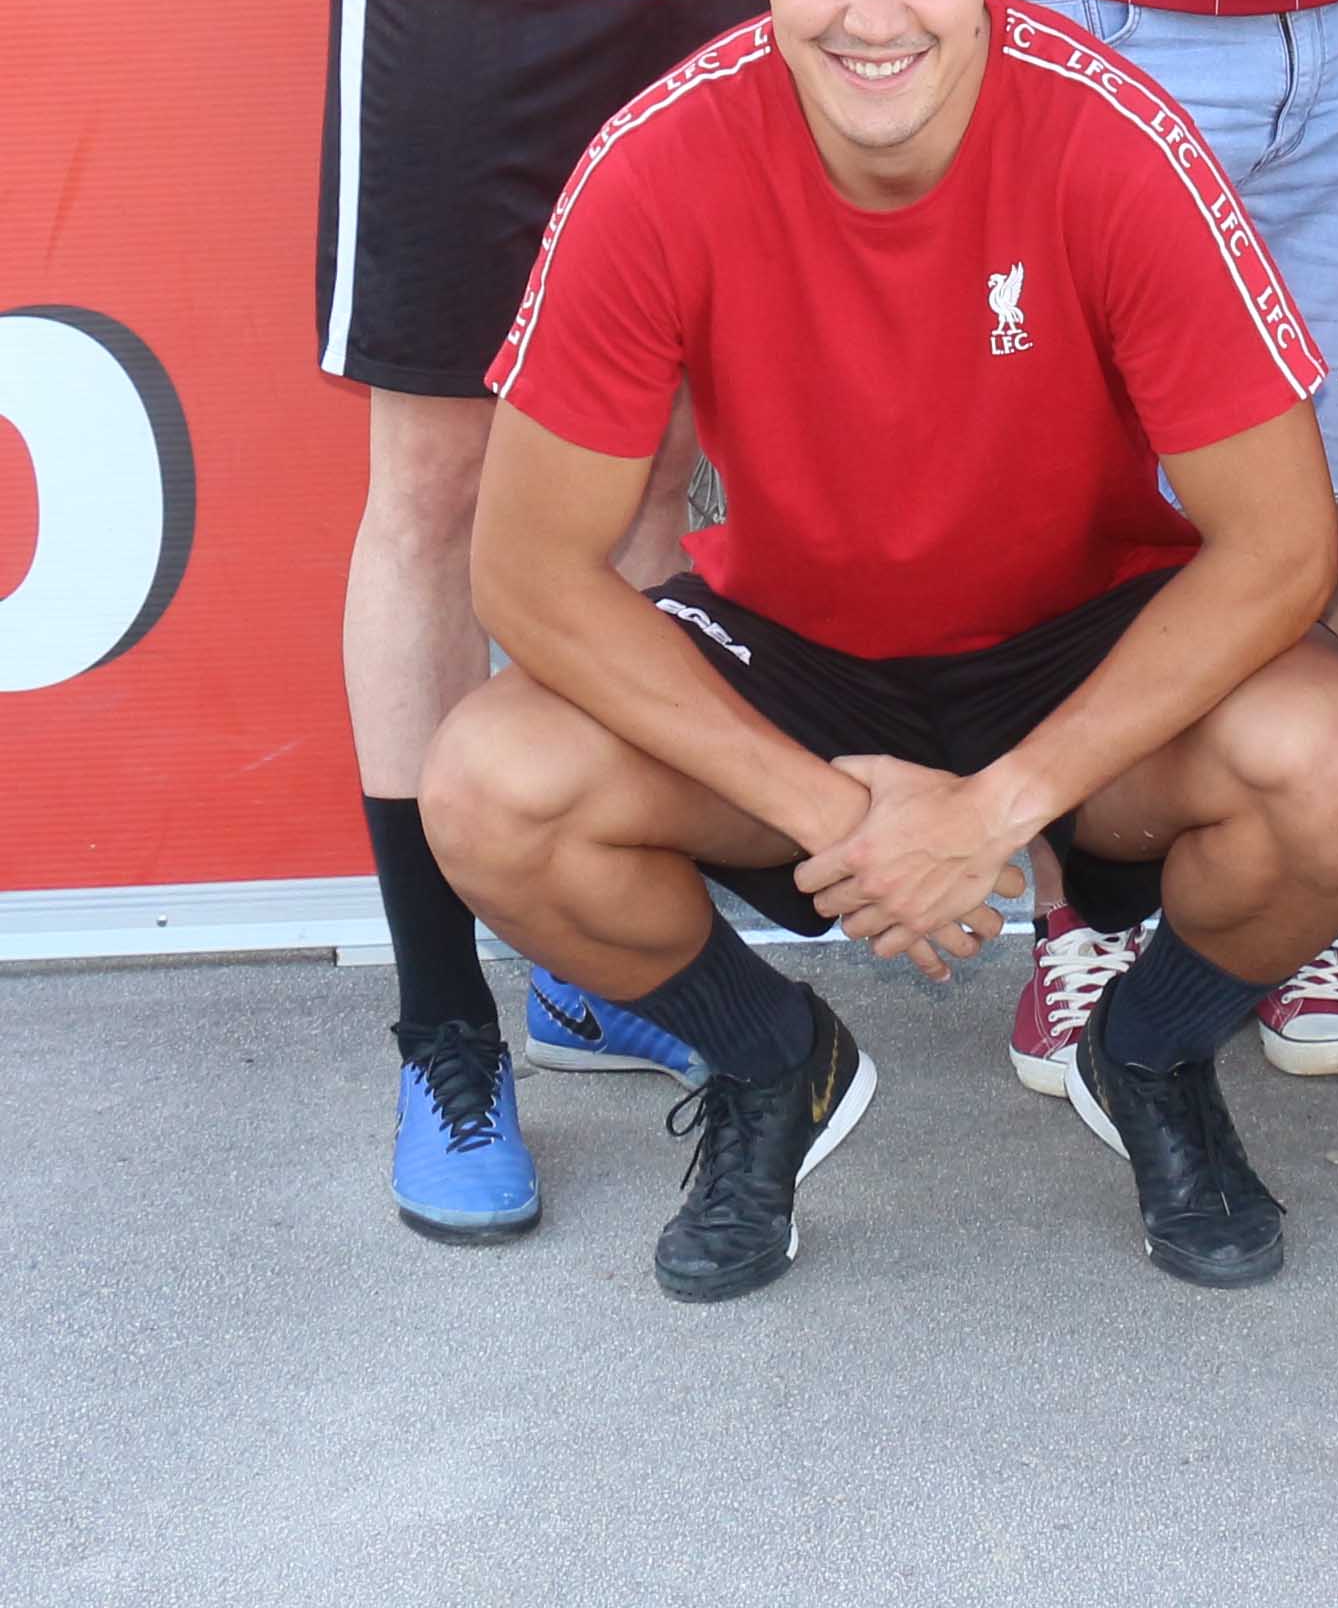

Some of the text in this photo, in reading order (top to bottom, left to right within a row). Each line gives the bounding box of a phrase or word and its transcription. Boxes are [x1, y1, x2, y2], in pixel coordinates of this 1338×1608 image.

[666, 52, 720, 91] LFC
[1066, 50, 1123, 93] LFC
[1150, 110, 1198, 168] LFC
[1211, 193, 1249, 257] LFC
[1257, 286, 1297, 348] LFC
